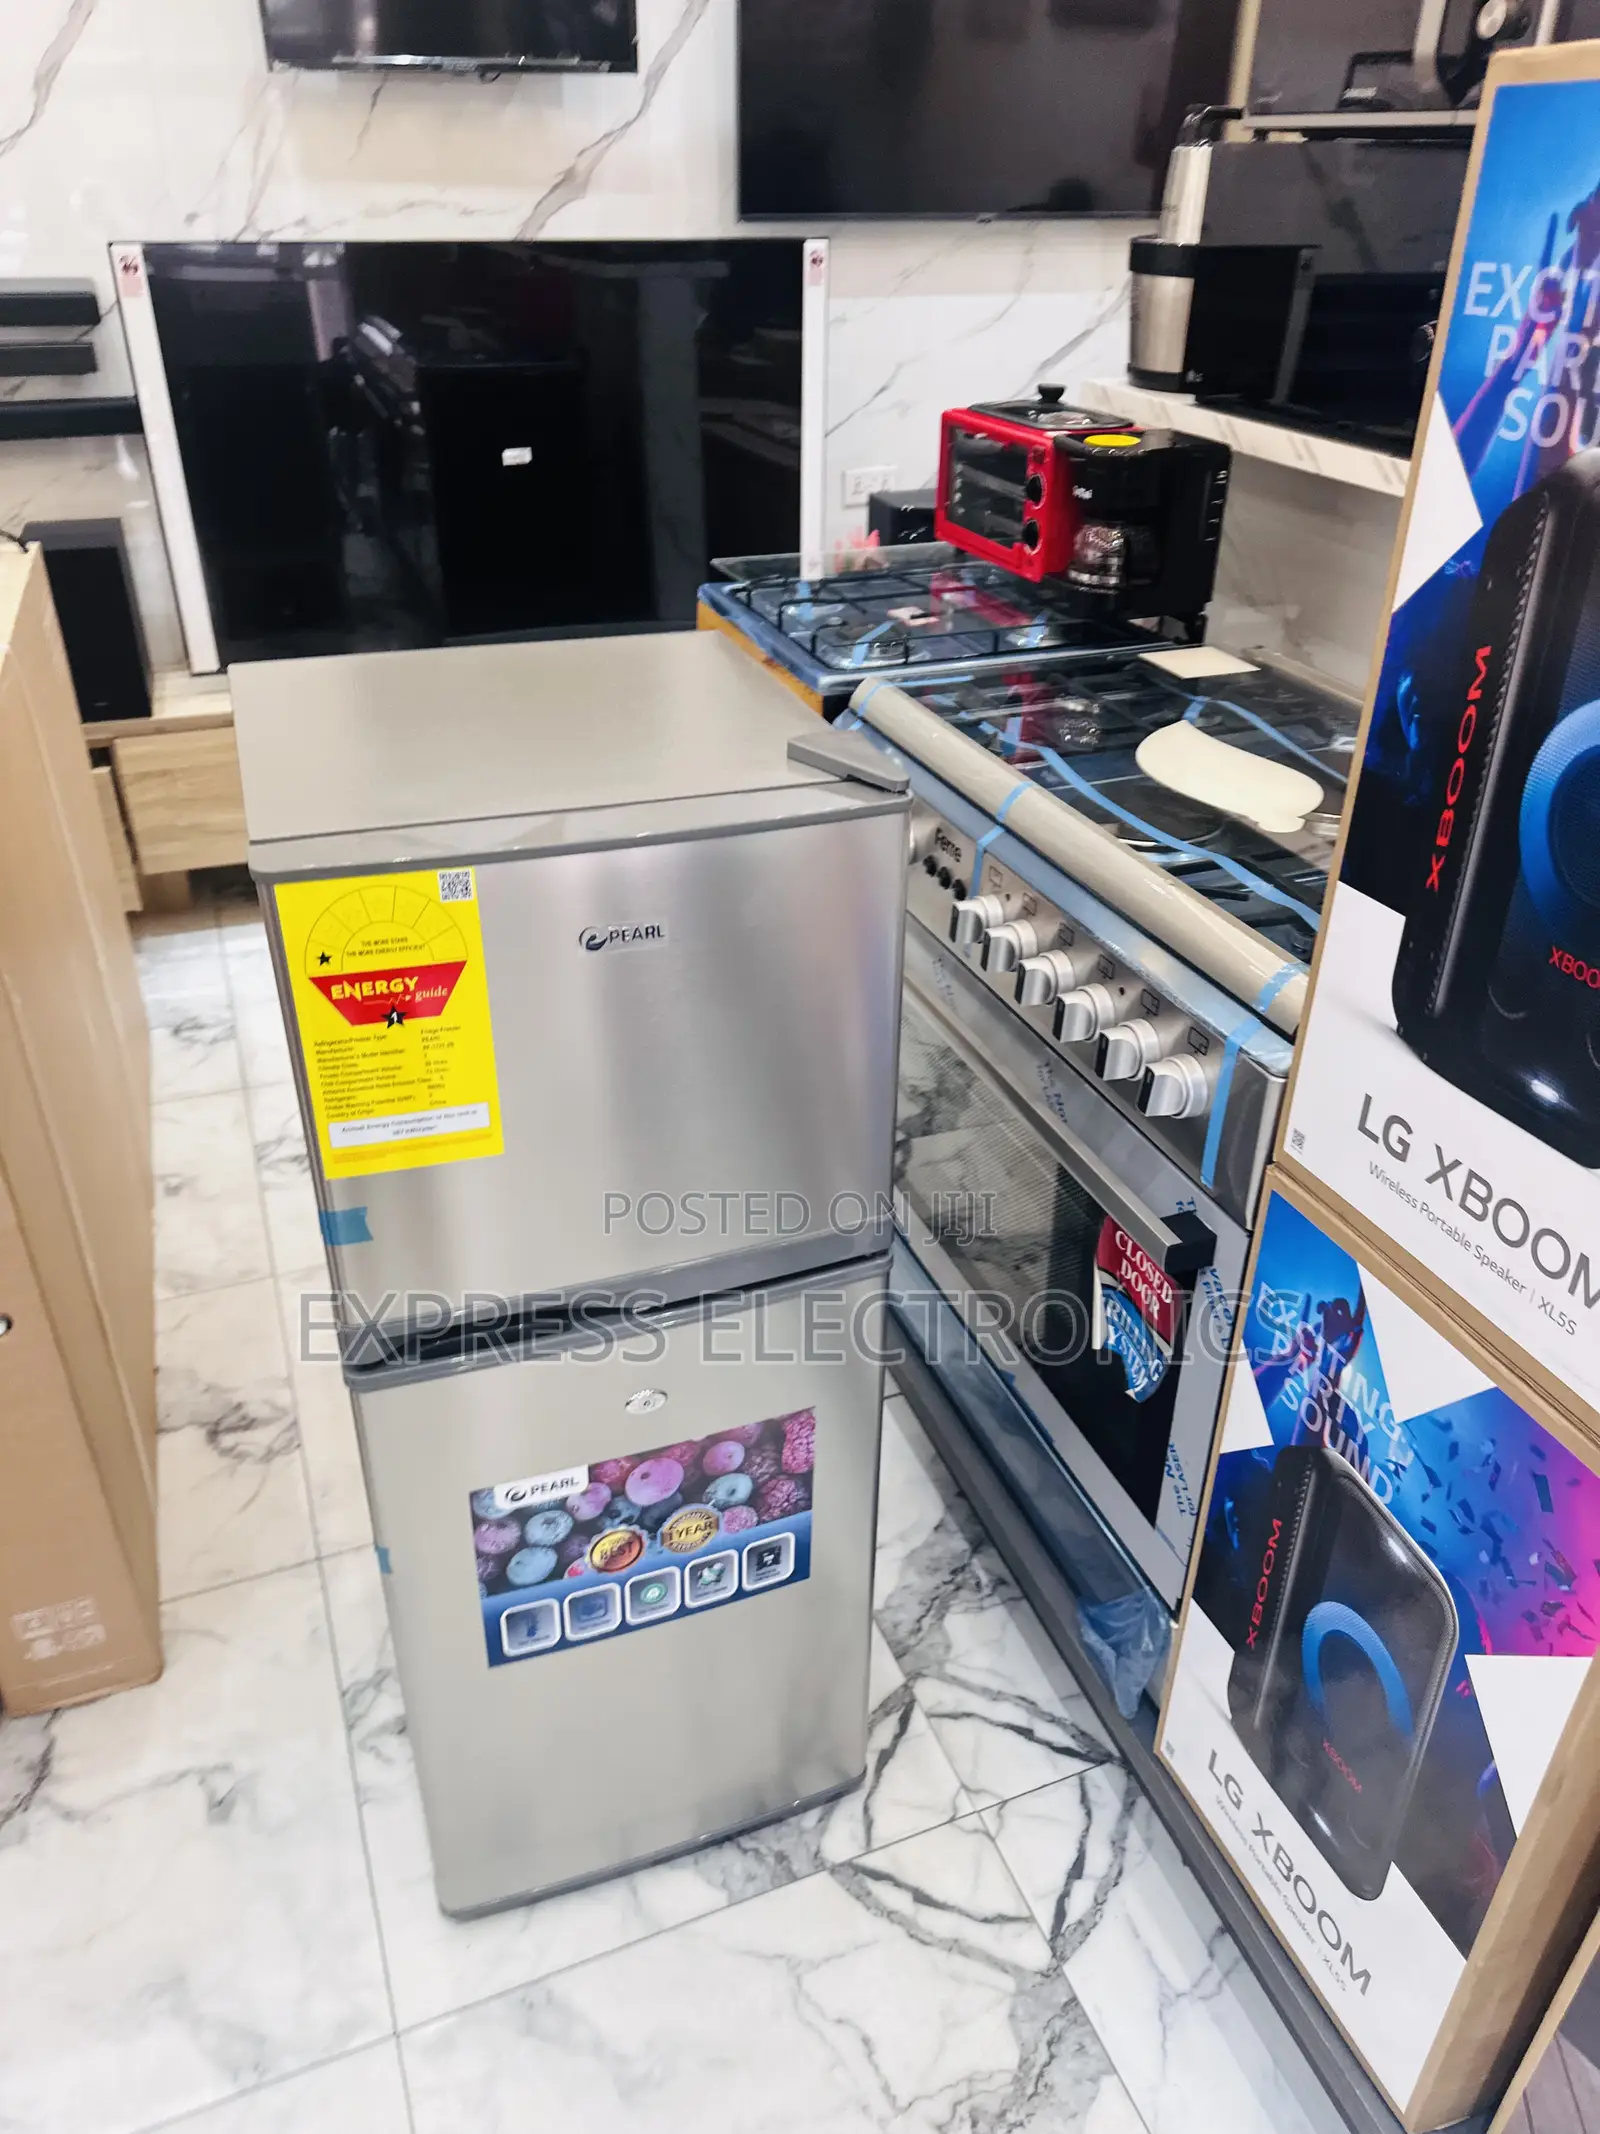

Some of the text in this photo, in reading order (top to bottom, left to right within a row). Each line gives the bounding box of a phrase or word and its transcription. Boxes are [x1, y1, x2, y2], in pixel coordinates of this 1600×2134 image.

[1425, 645, 1492, 892] XBOOM
[609, 924, 665, 944] PEARL
[1548, 945, 1600, 989] XBOO
[330, 975, 419, 1003] ENERGY
[390, 1011, 398, 1024] 1
[414, 984, 449, 1004] guide
[1357, 1092, 1414, 1163] LG
[1114, 1229, 1174, 1305] CLOSED
[1368, 1160, 1578, 1336] Wireless Portable Speaker XL5S
[1120, 1256, 1161, 1321] DOOR
[1103, 1294, 1163, 1382] RILLING
[1107, 1324, 1149, 1392] YSTEM
[1257, 1281, 1404, 1442] EXCITING
[1271, 1329, 1376, 1445] PARTY
[1279, 1376, 1394, 1505] SOUND
[530, 1476, 580, 1496] PEARL
[676, 1521, 715, 1540] YEAR
[1245, 1518, 1284, 1648] XBOOM
[1322, 1739, 1363, 1793] XBOOM
[1208, 1748, 1373, 1996] LG XBOOM
